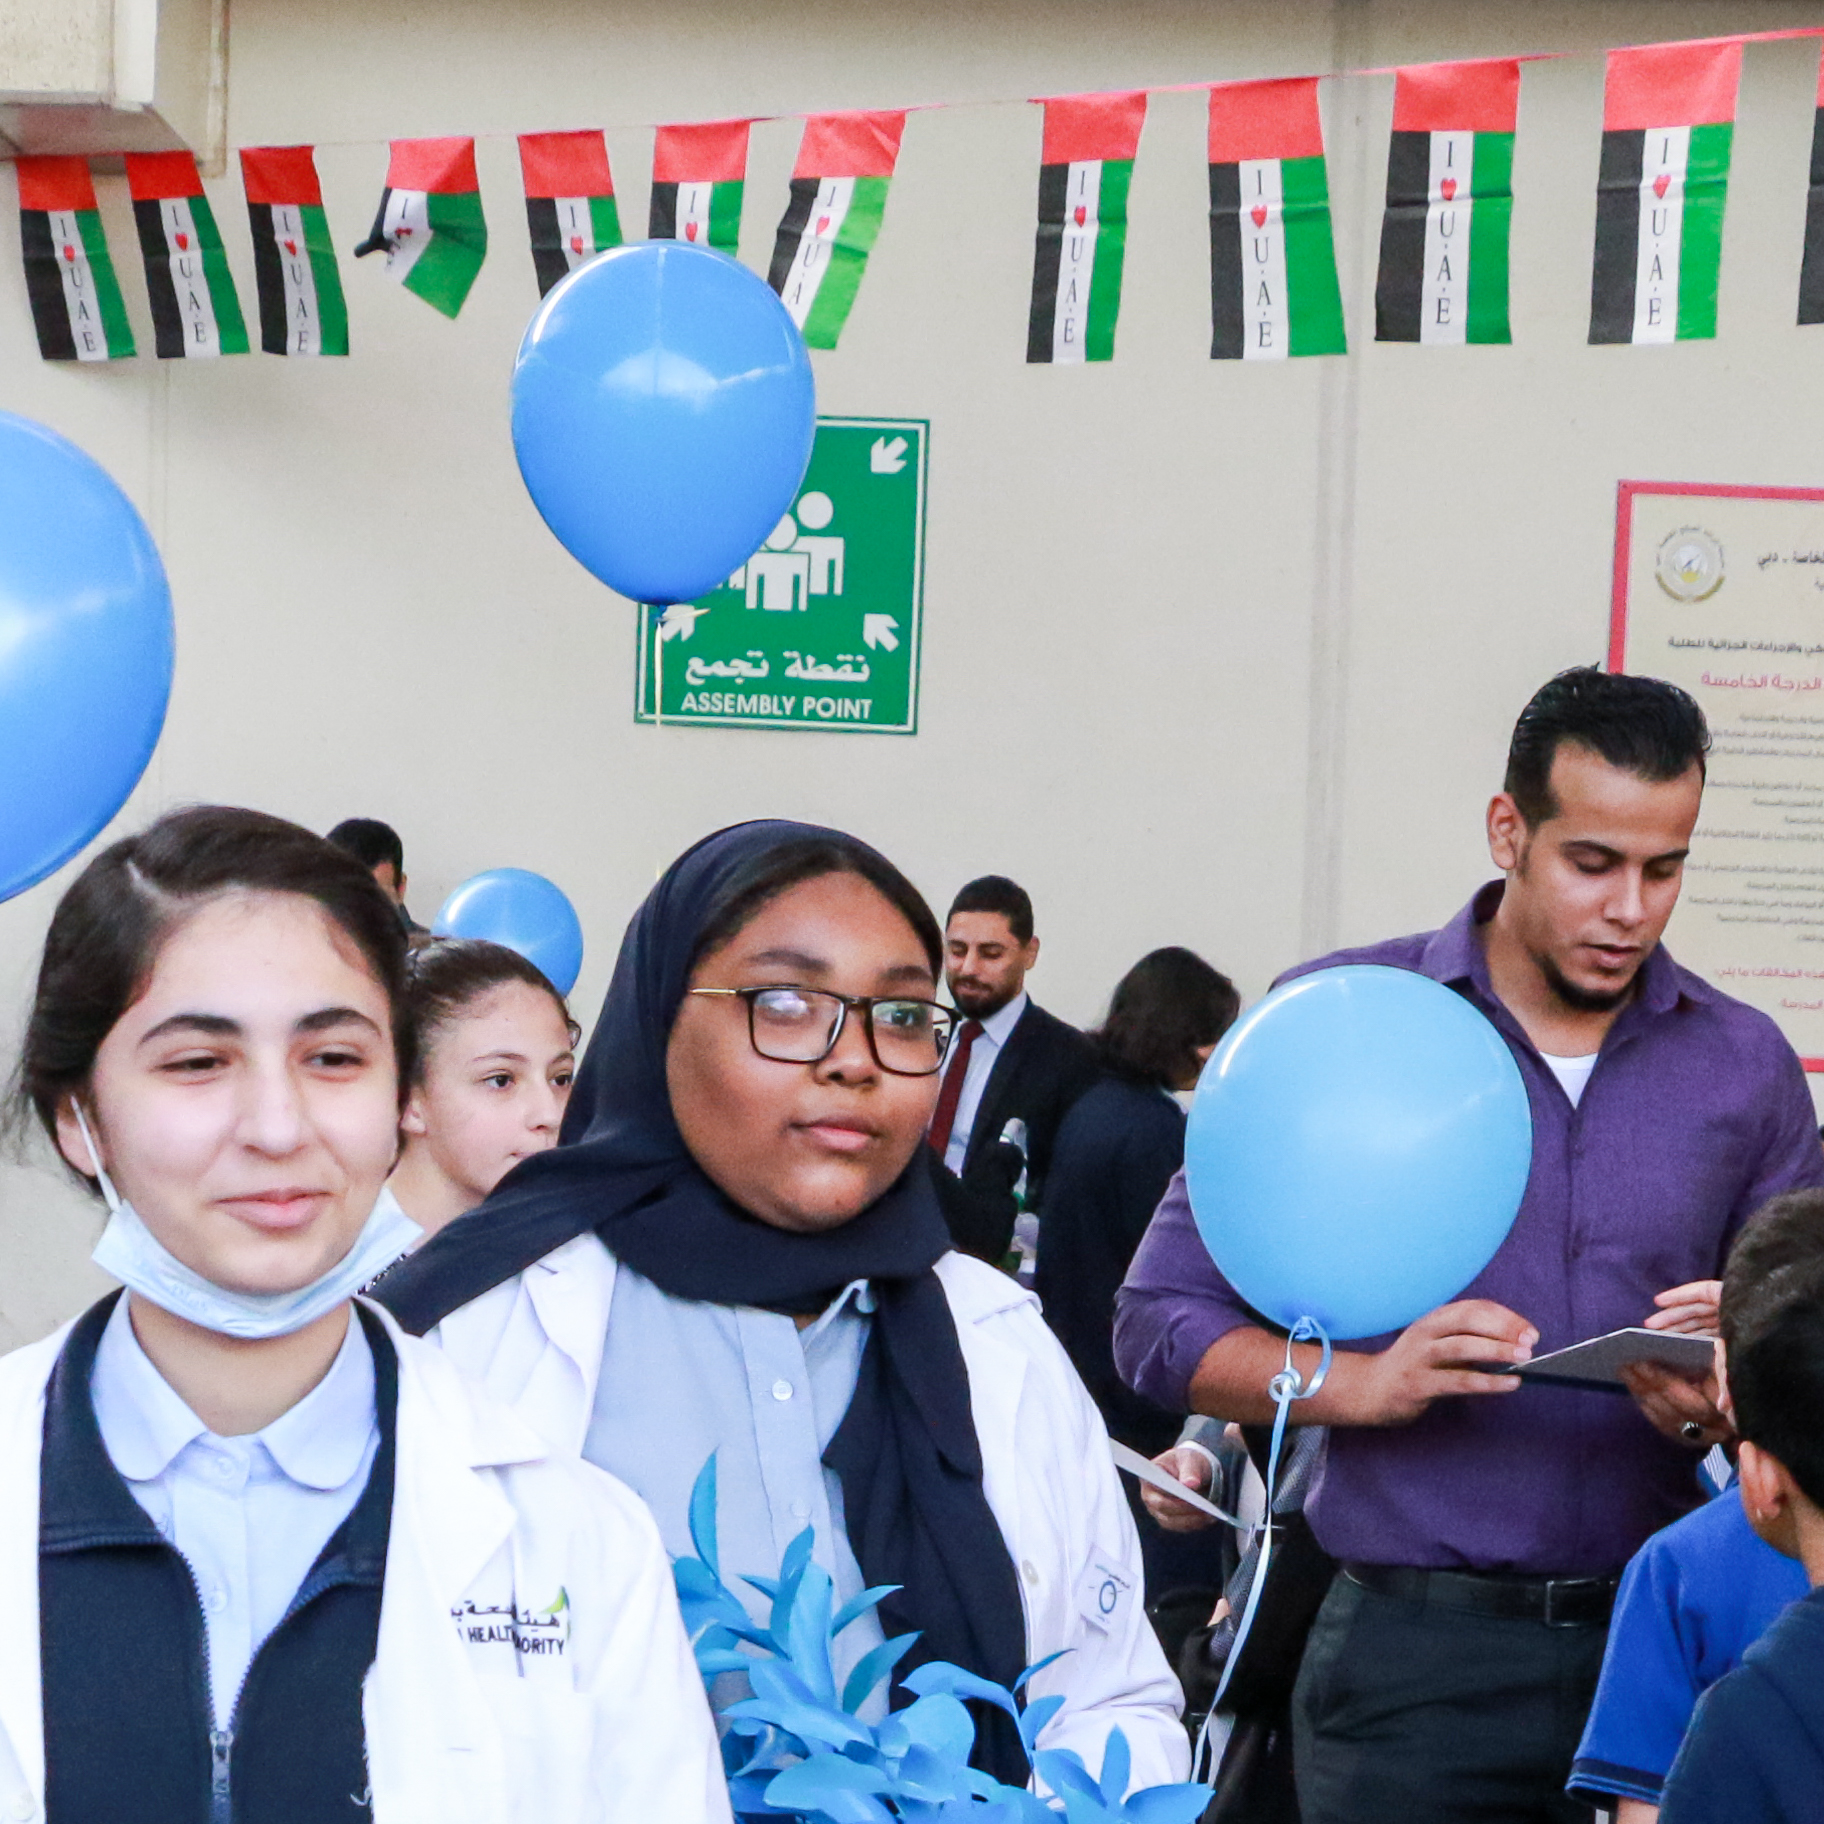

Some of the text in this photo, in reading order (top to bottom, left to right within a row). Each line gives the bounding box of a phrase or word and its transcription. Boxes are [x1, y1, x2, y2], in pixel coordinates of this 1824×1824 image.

[1445, 140, 1455, 168] I
[1661, 137, 1671, 165] I
[1079, 170, 1087, 196] I
[1256, 169, 1264, 196] I
[1758, 552, 1778, 570] دبي
[684, 650, 870, 685] نقطة تجمع
[1701, 670, 1768, 688] الخامسة
[1771, 674, 1821, 692] الدرجة
[681, 692, 872, 719] ASSEMBLY POINT
